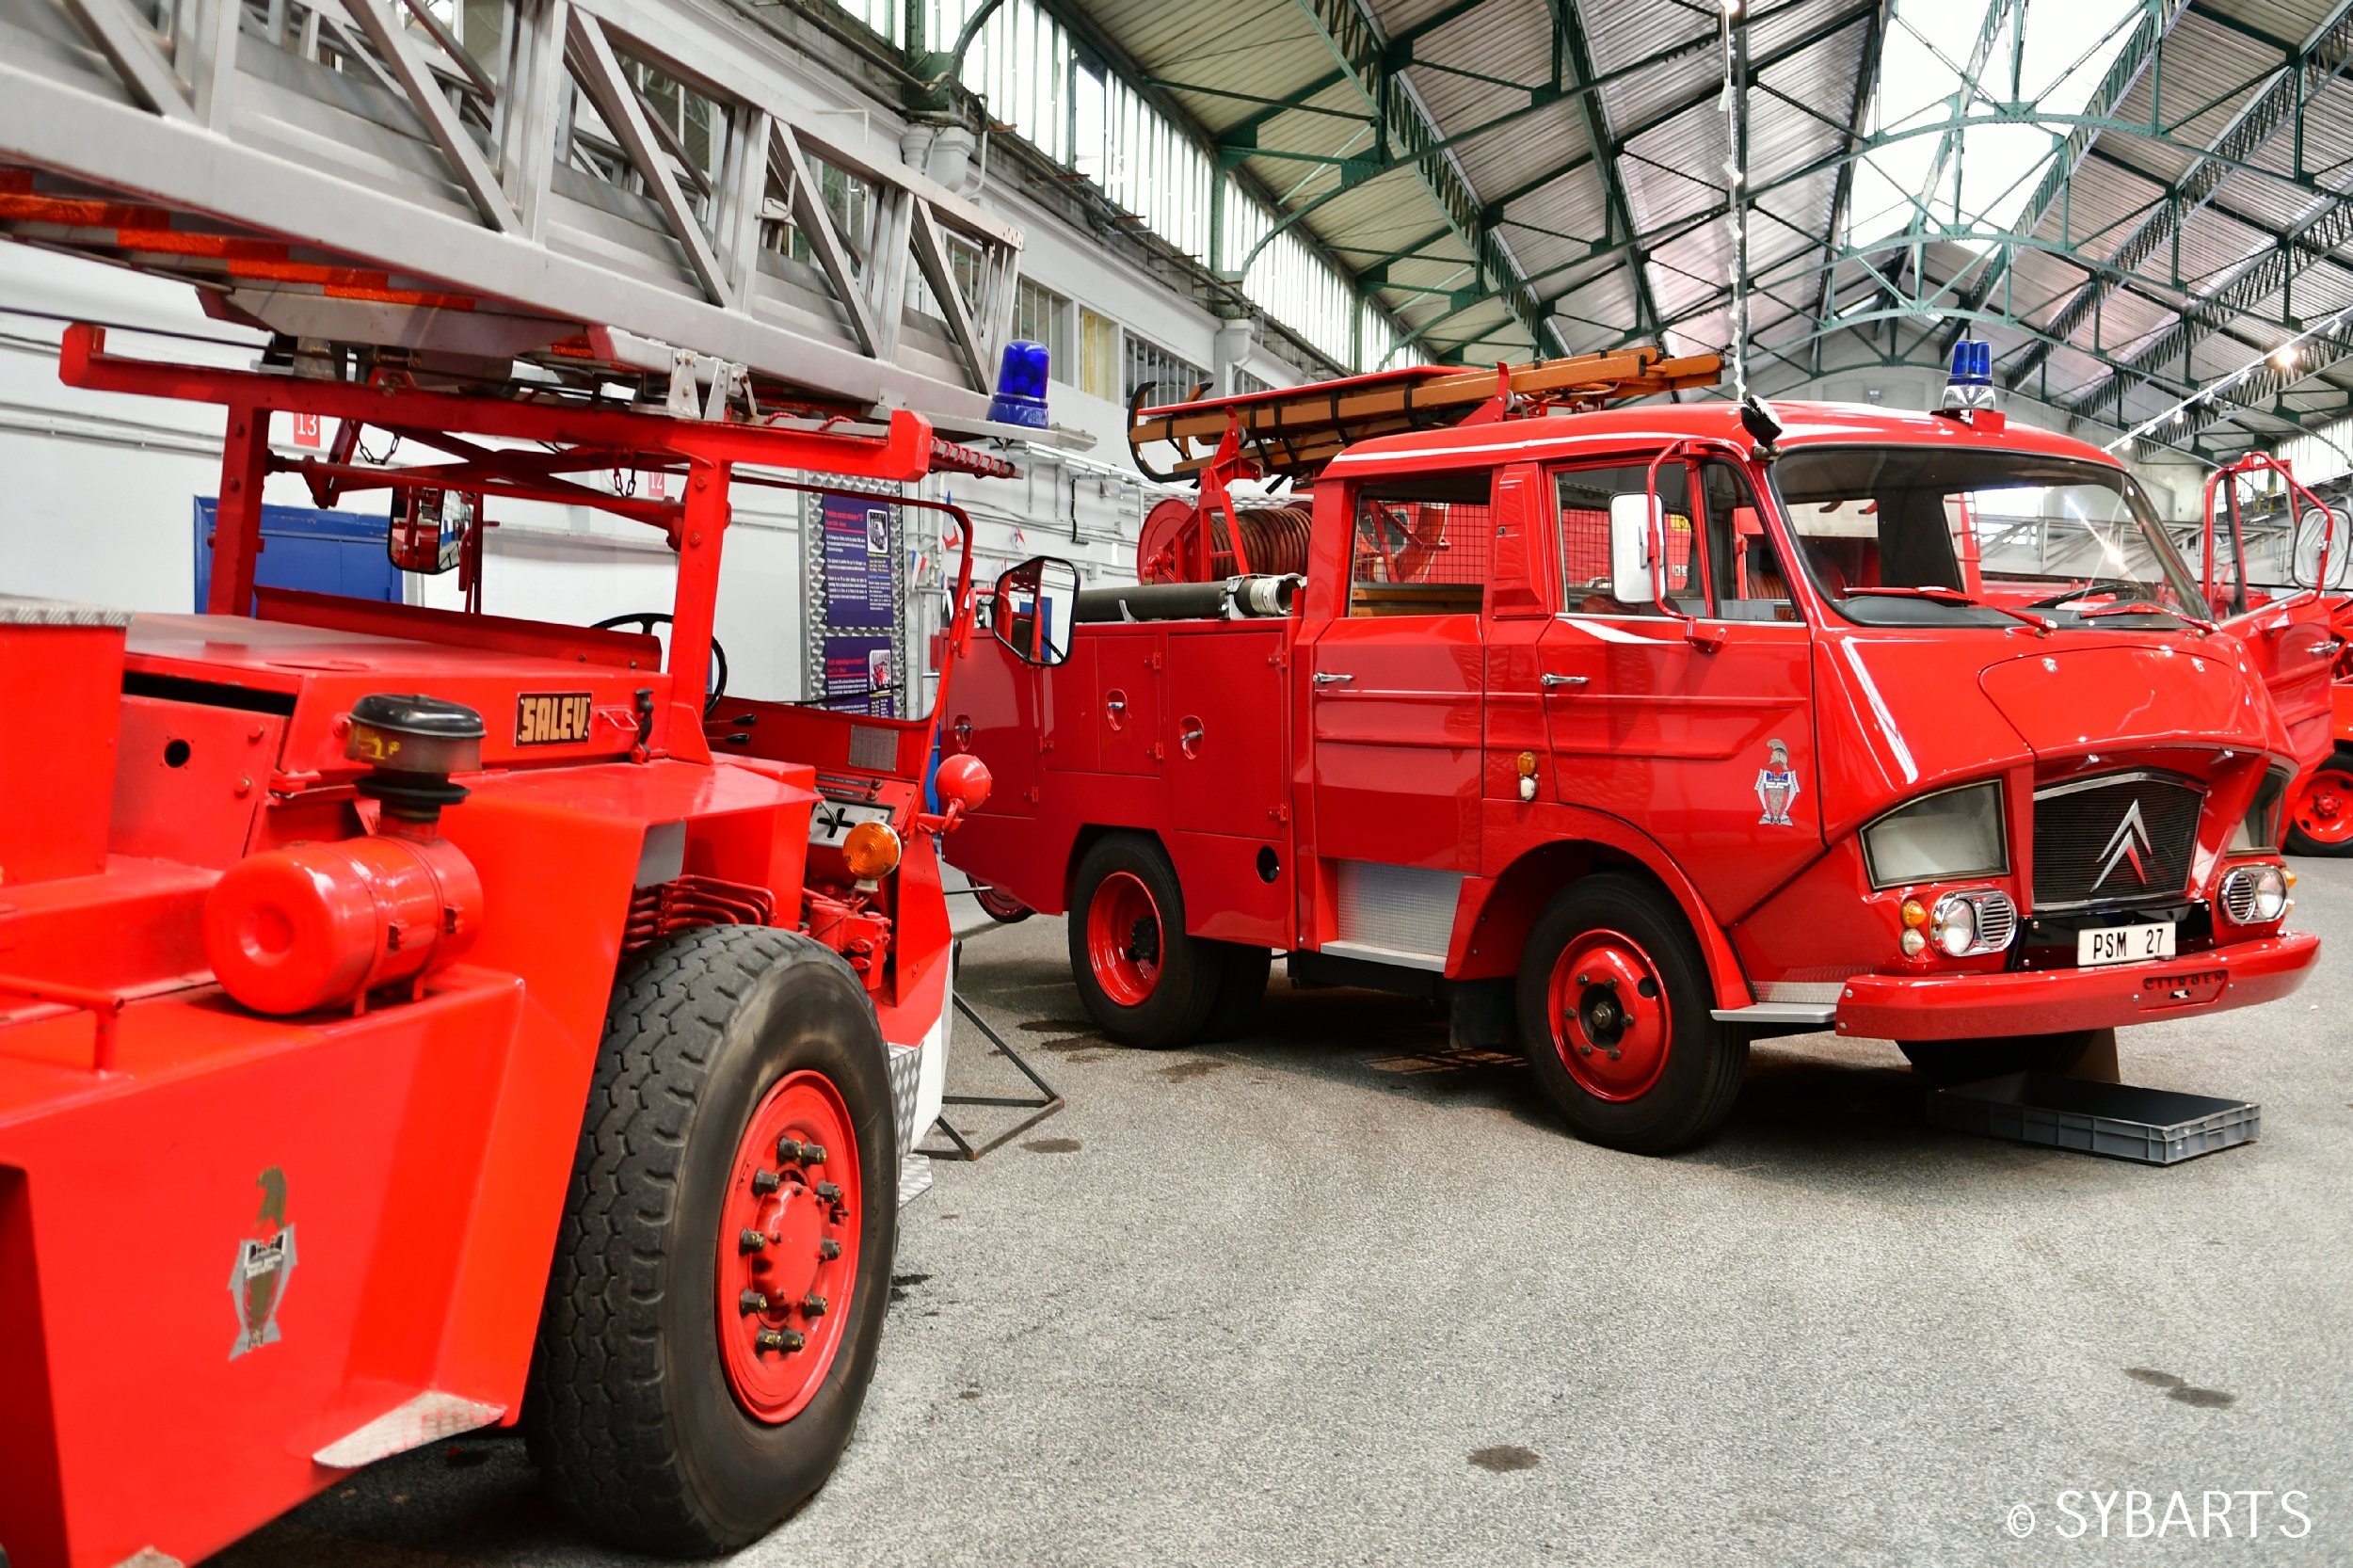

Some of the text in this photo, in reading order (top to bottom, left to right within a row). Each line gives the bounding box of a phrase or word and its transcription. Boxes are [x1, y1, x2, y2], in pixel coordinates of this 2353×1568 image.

[296, 412, 317, 437] 13
[520, 696, 587, 743] SALEV
[2093, 928, 2164, 960] PSM 27
